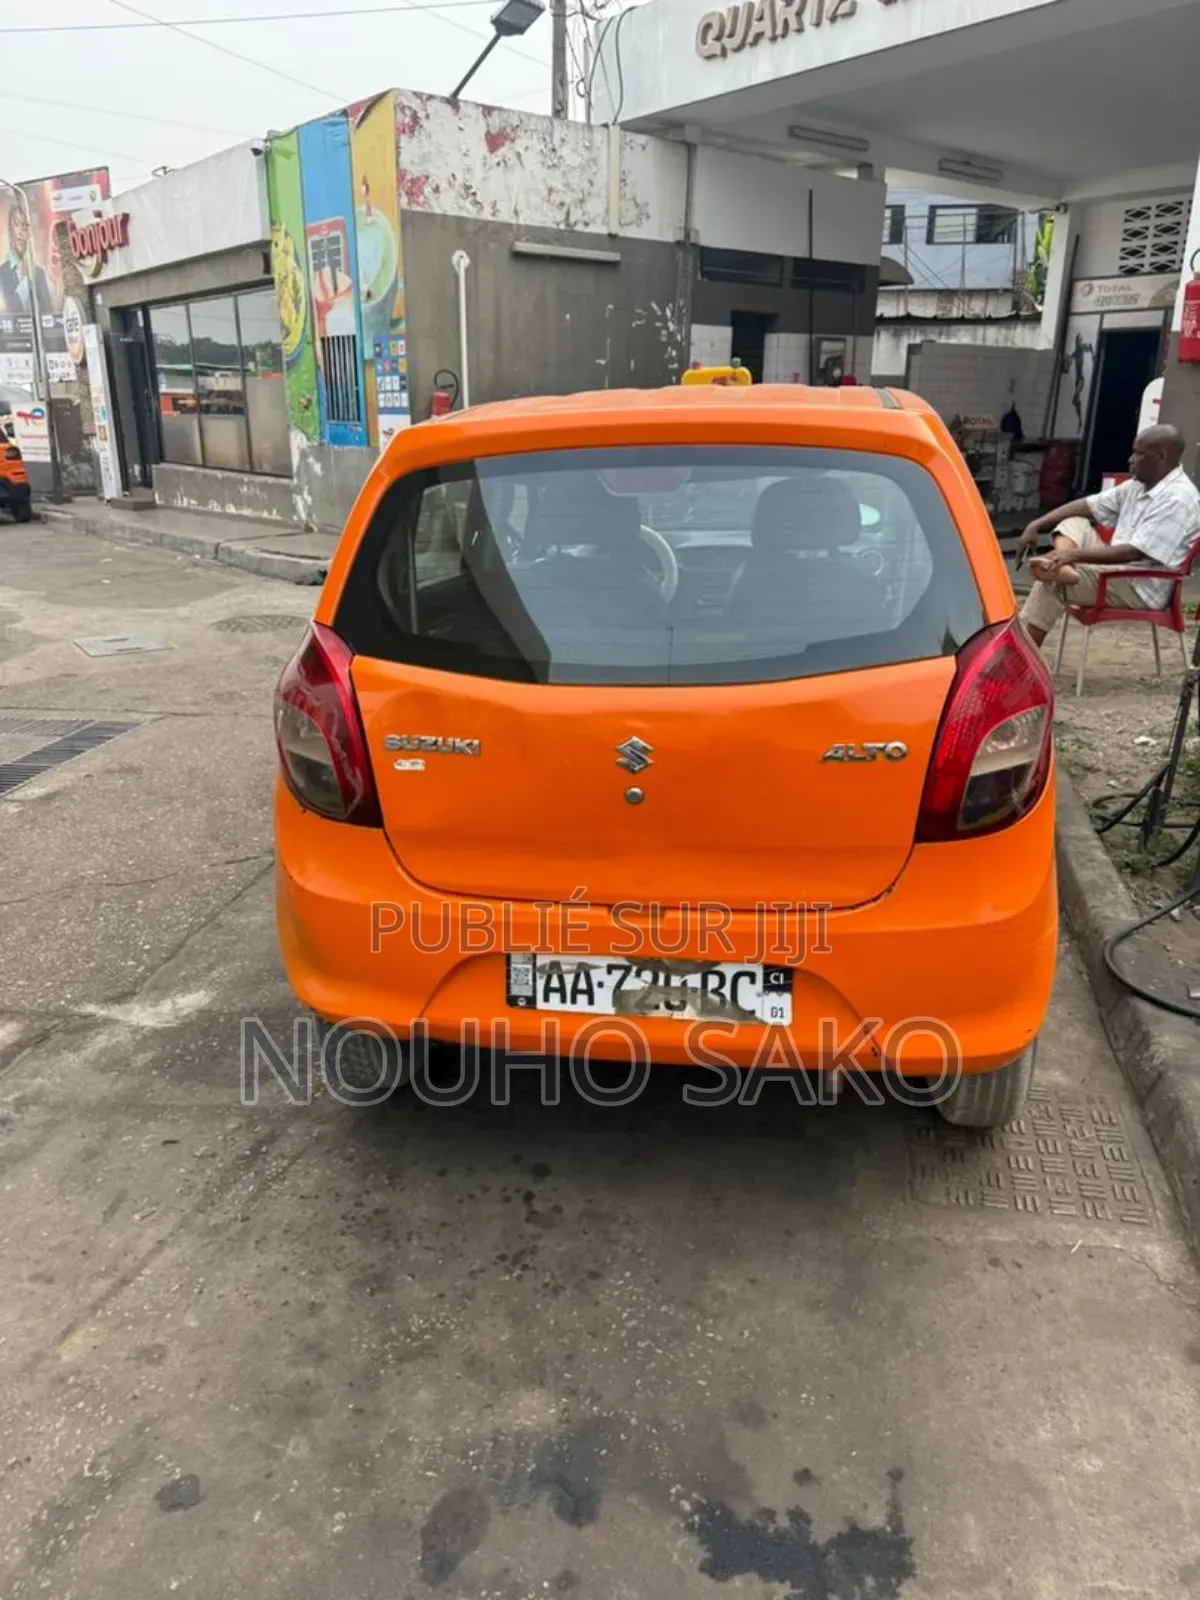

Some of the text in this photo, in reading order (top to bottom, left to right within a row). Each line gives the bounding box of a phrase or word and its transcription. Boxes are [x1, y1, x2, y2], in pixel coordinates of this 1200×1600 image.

[66, 210, 130, 263] bonjour
[384, 734, 480, 757] SUZUKI
[820, 741, 907, 764] ALTO
[769, 971, 785, 985] CI
